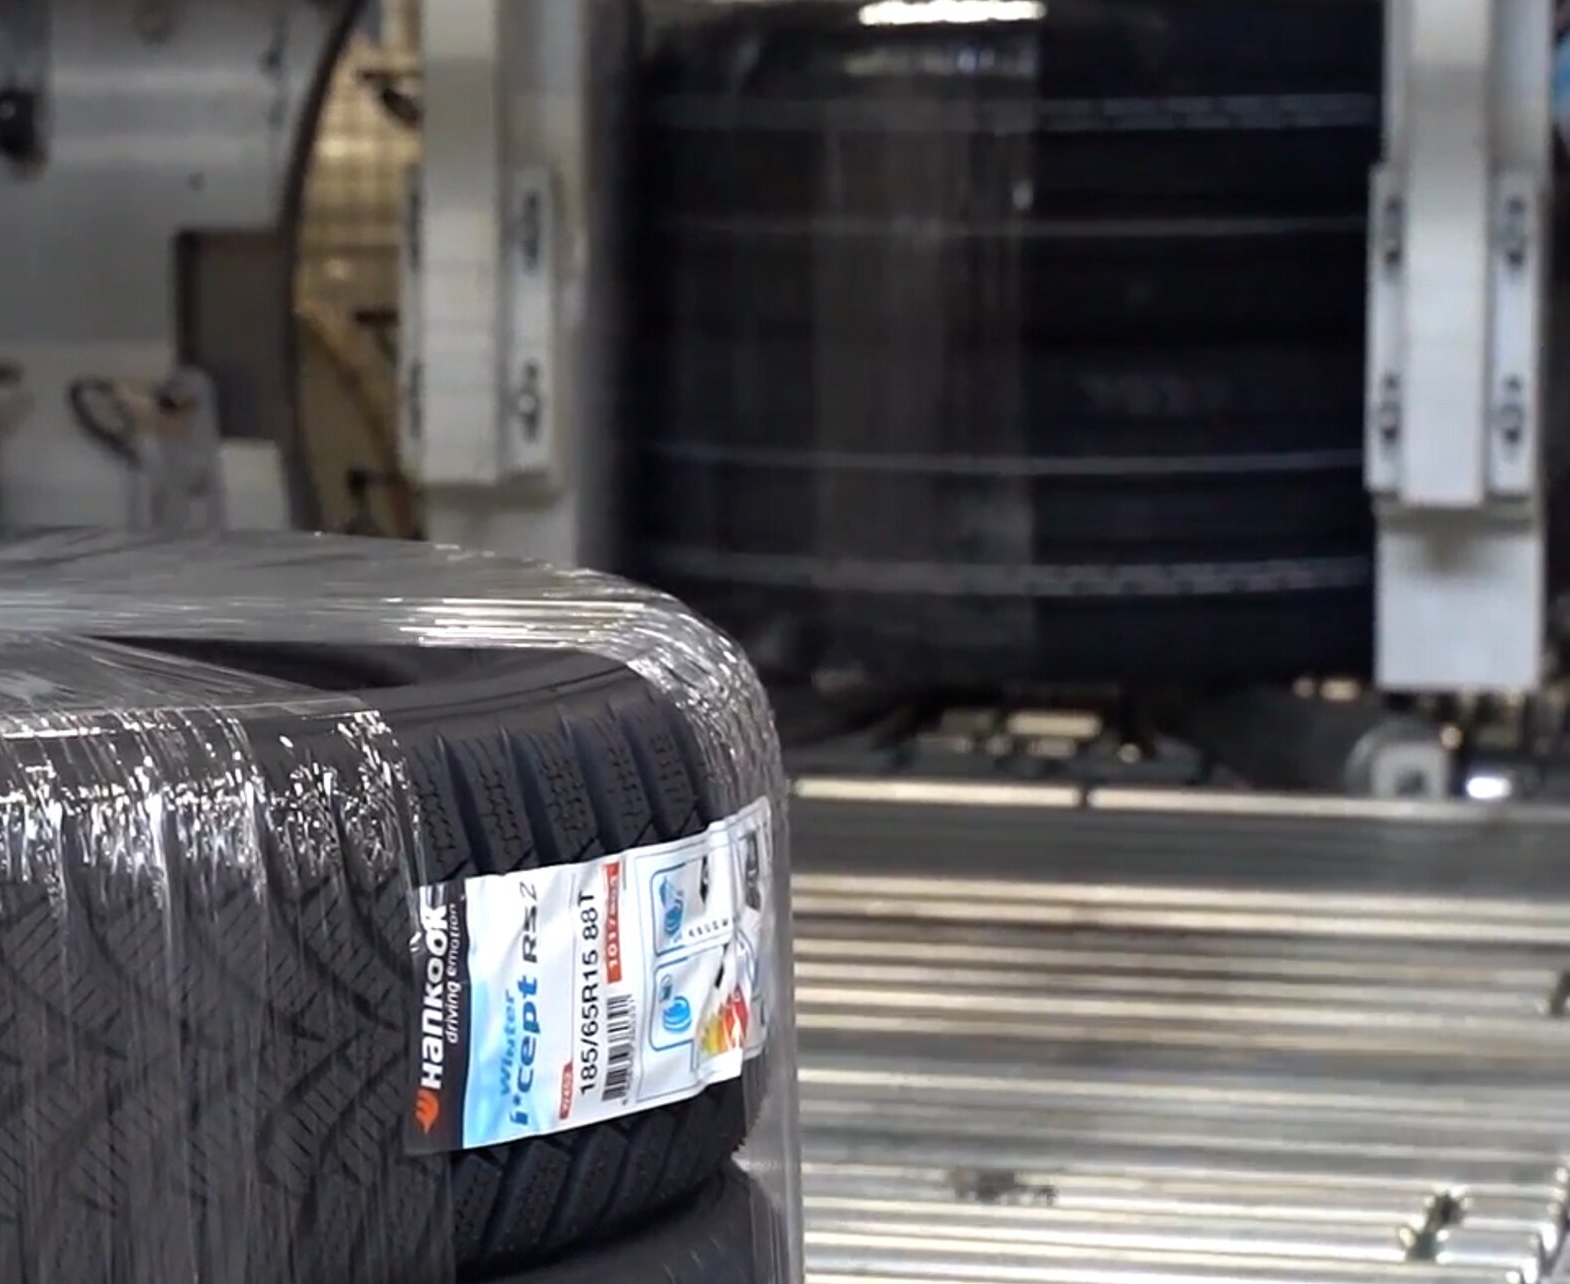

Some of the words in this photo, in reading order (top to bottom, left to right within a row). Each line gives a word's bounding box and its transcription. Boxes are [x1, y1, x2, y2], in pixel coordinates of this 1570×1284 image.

[446, 903, 461, 977] emotion
[577, 889, 599, 941] 88T
[445, 981, 462, 1043] driving
[578, 950, 600, 1096] 185/65R15
